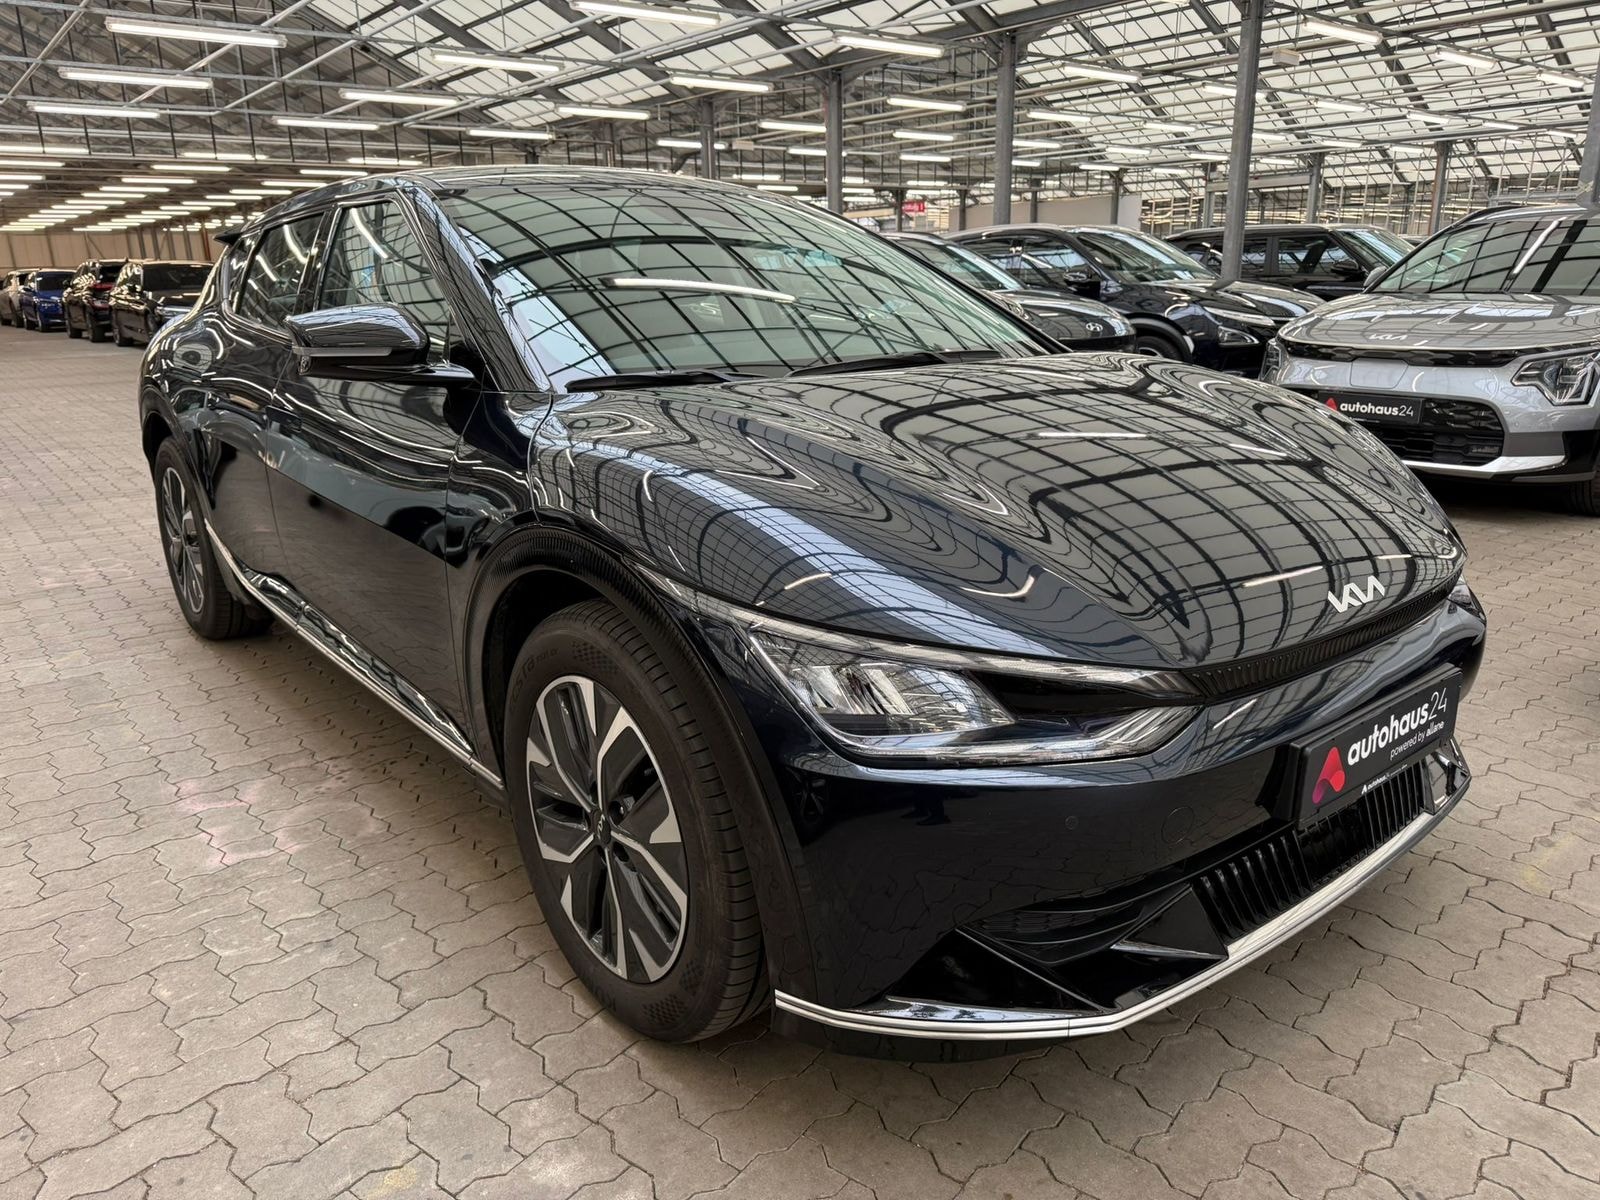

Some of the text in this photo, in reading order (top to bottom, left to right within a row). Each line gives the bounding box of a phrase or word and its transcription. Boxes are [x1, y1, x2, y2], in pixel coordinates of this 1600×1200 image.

[1340, 402, 1414, 417] autohaus24
[1328, 575, 1385, 613] KIA
[1347, 687, 1448, 766] autohaus24
[1390, 733, 1418, 761] powered
[1417, 731, 1426, 743] by
